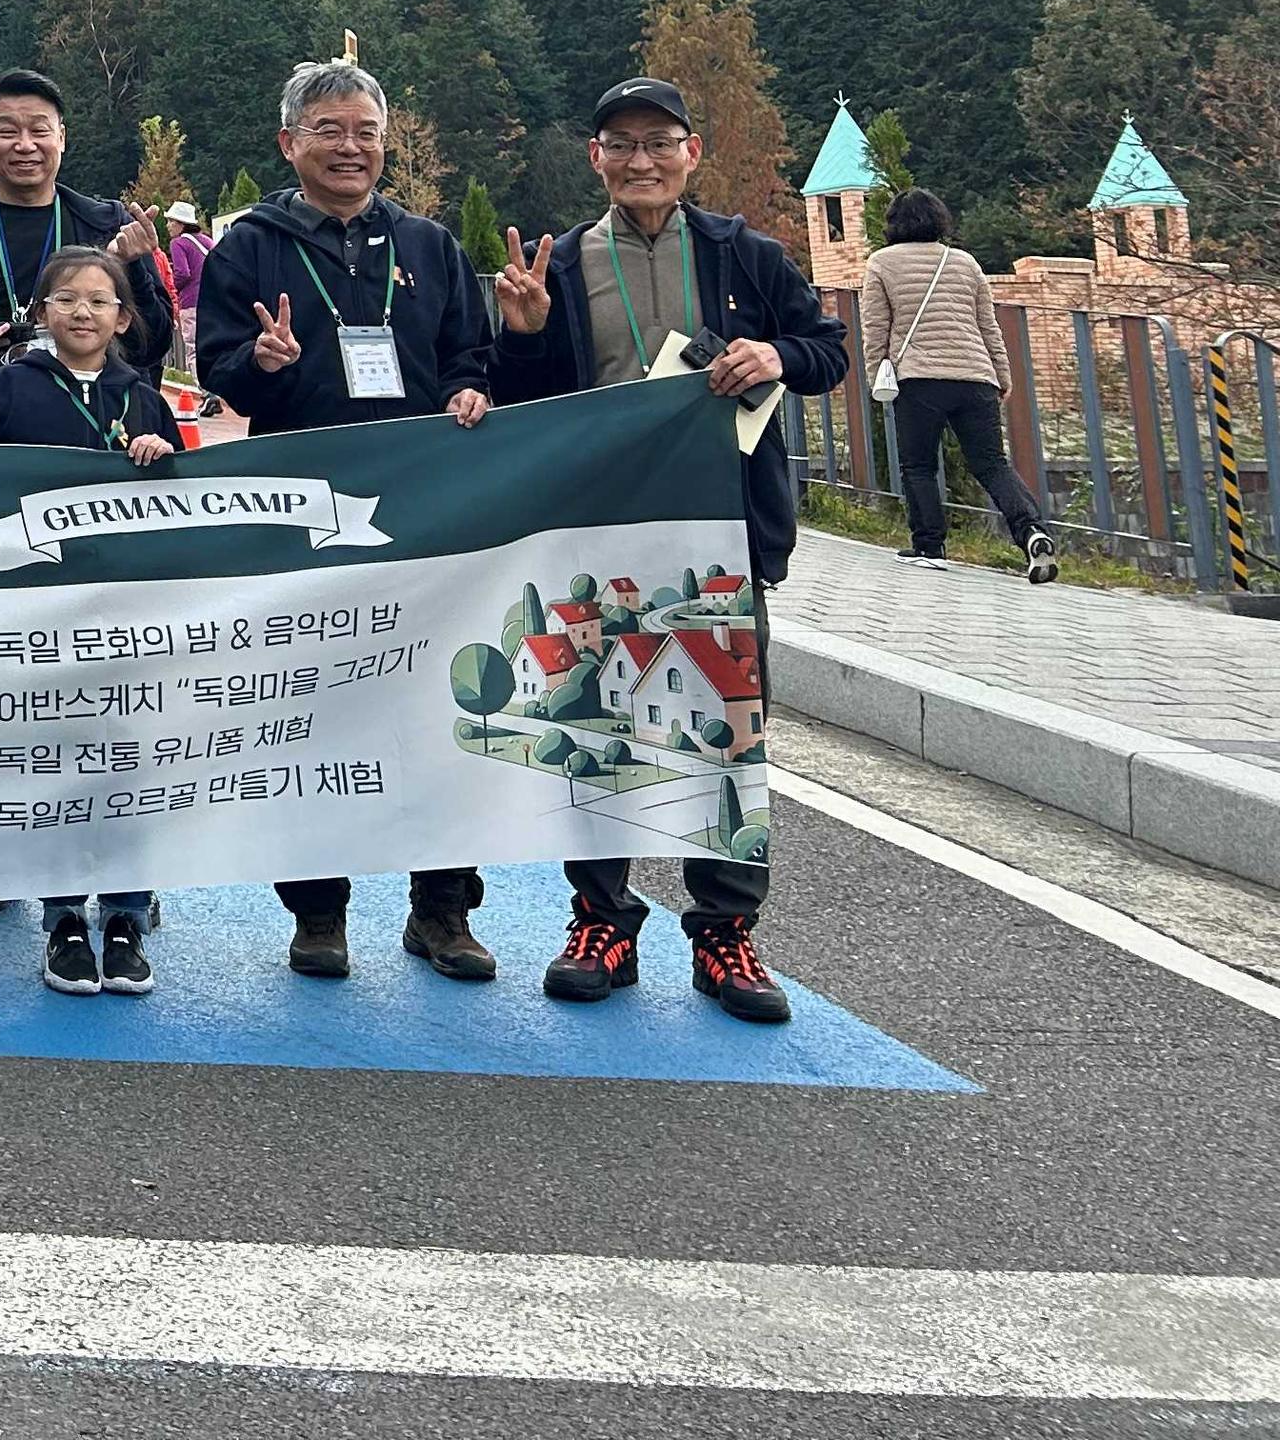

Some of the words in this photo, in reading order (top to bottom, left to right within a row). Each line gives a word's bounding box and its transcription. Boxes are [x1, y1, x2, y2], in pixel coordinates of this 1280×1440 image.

[42, 492, 192, 531] GERMAN
[200, 491, 308, 515] CAMP
[71, 623, 175, 662] 문화의
[185, 620, 221, 655] 밤
[229, 618, 253, 650] &
[262, 606, 360, 646] 음악의
[370, 601, 403, 635] 밤
[74, 741, 140, 775] 전통
[151, 726, 244, 767] 유니폼
[253, 712, 315, 749] 체험
[102, 781, 199, 821] 오르골
[208, 764, 304, 804] 만들기
[313, 760, 385, 797] 체험
